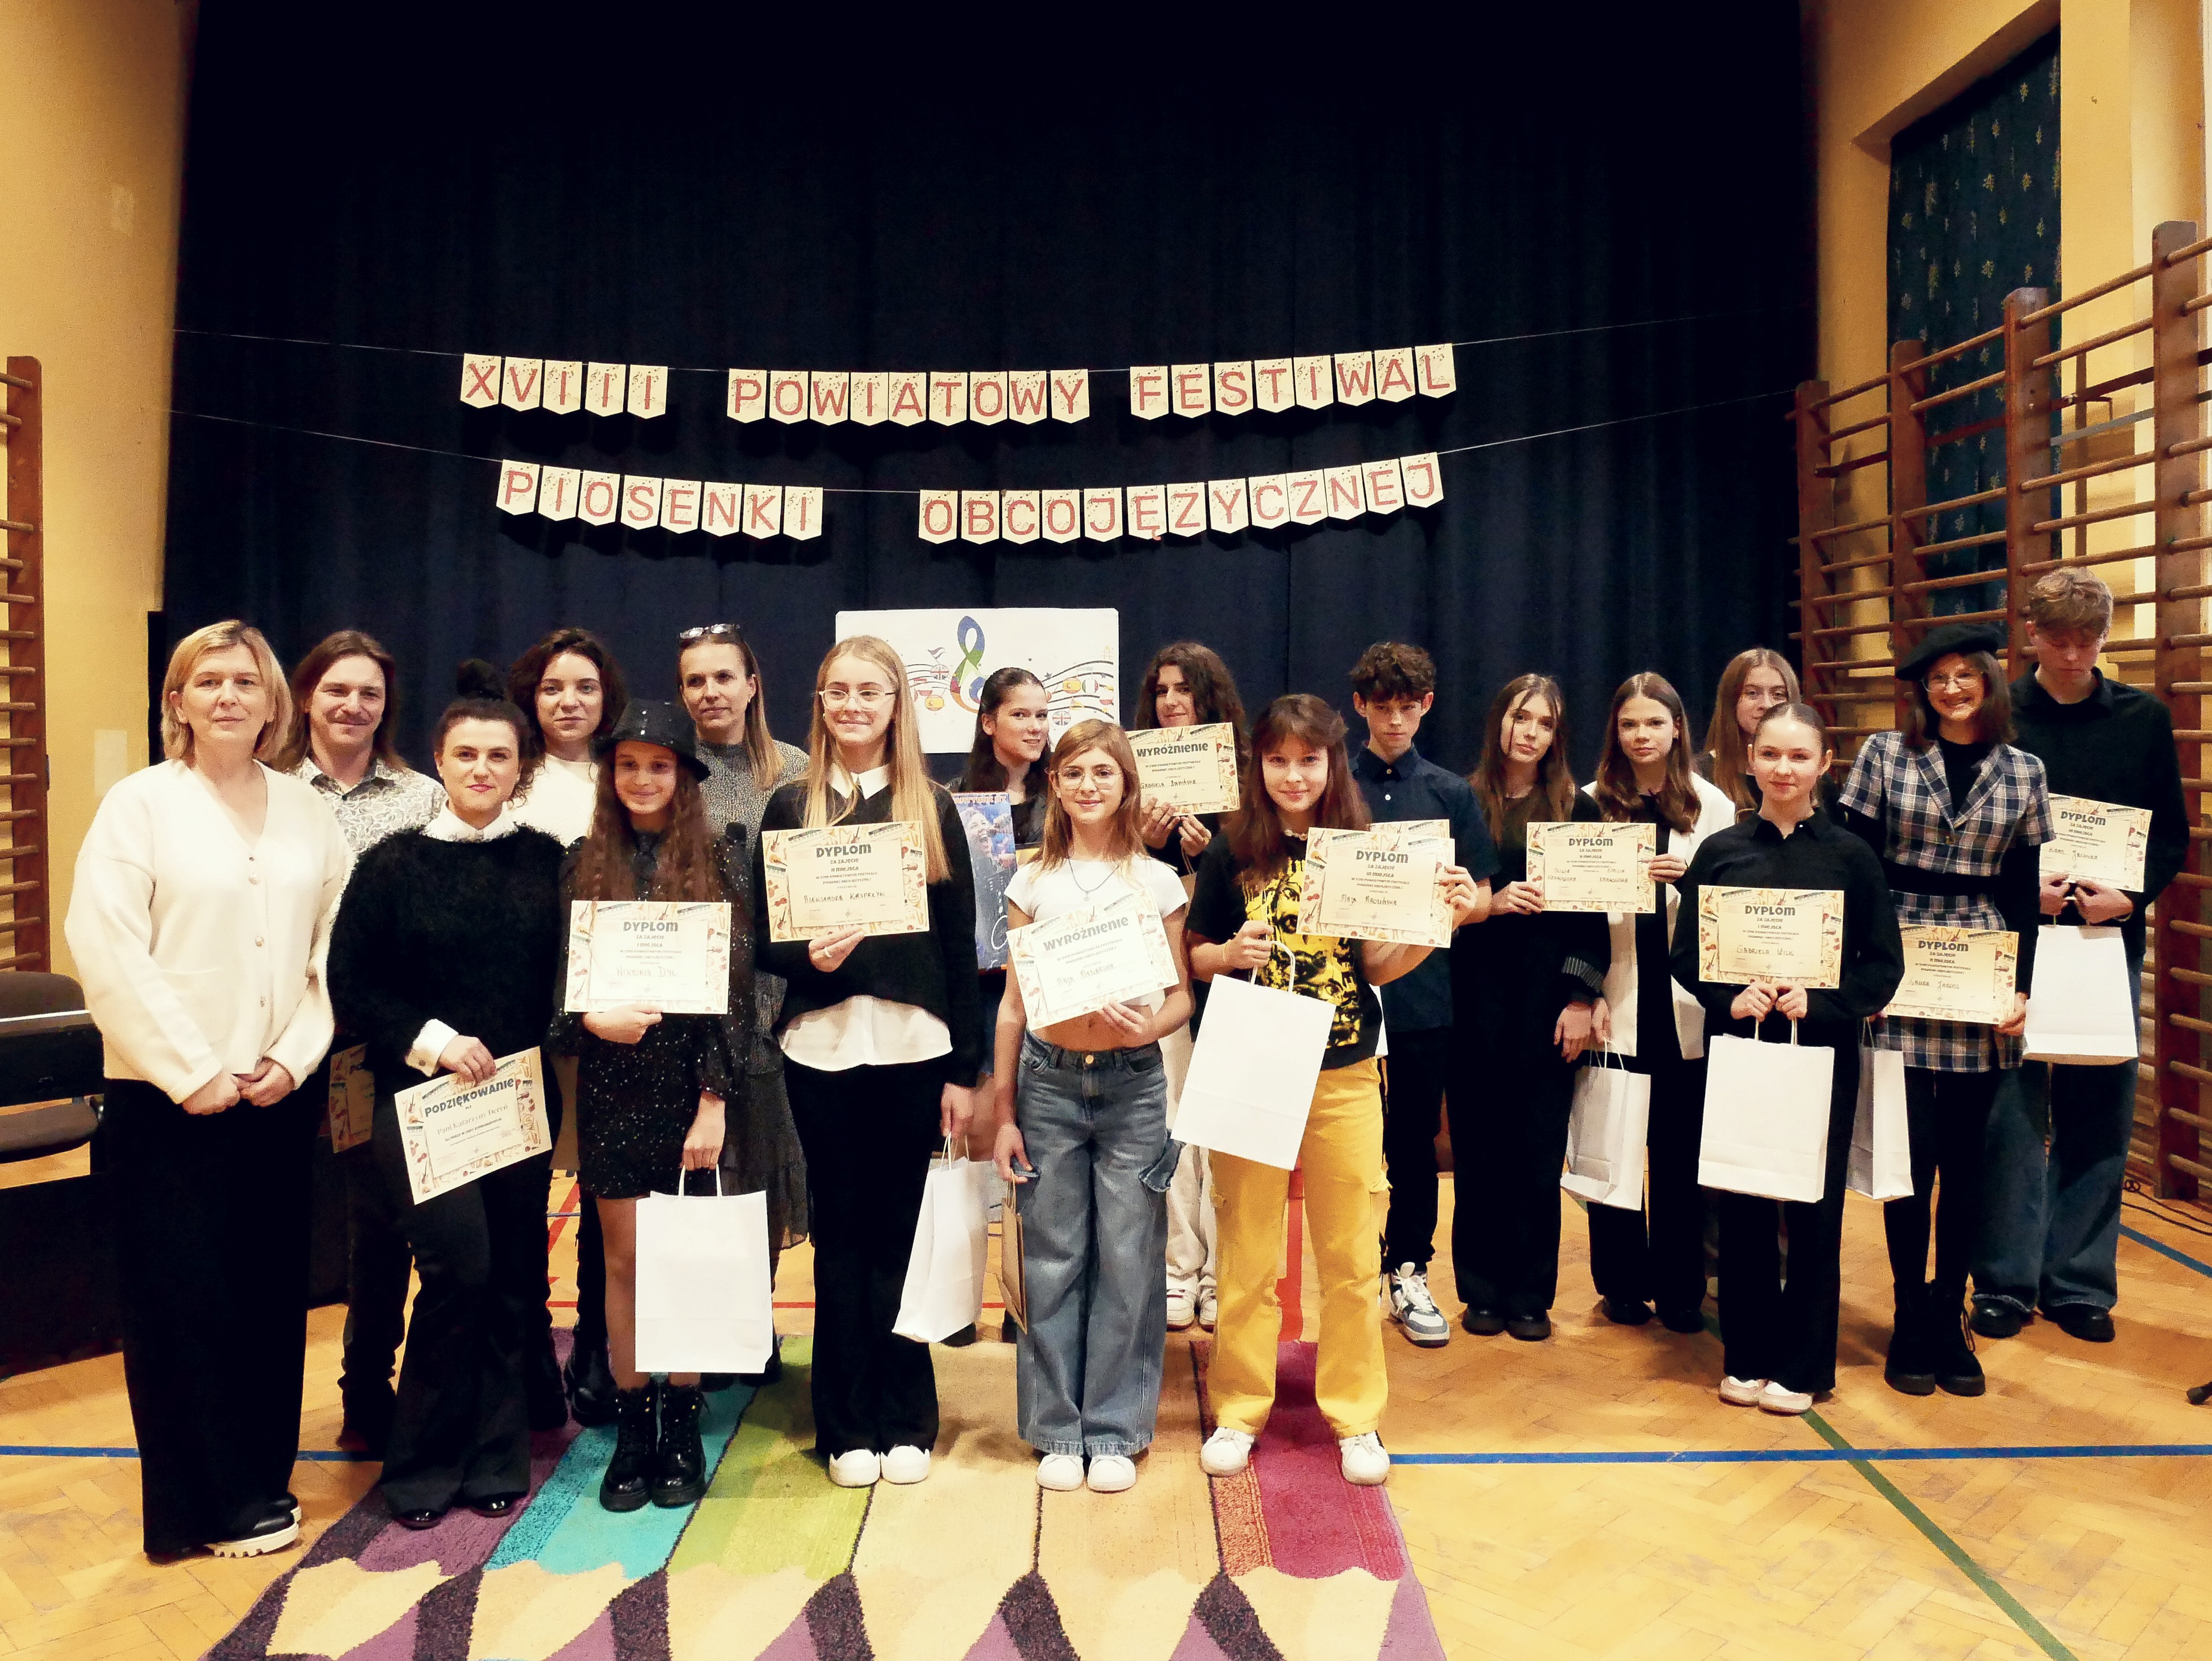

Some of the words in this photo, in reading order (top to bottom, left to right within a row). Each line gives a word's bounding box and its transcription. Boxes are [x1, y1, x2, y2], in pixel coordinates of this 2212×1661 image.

[465, 363, 652, 410] XVIII
[733, 378, 1085, 418] POWIATOWY
[1140, 355, 1452, 408] FESTIWAL
[504, 471, 807, 532] PIOSENKI
[924, 463, 1436, 541] OBCOJĘZYCZNEJ
[1136, 742, 1209, 757] WYRÓŻNIENIE
[2061, 811, 2106, 825] DYPLOM
[1569, 838, 1613, 846] DYPLOM
[816, 843, 872, 858] DYPLOM
[1356, 850, 1408, 863] DYPLOM
[1745, 905, 1795, 916] DYPLOM
[623, 921, 678, 932] DYPLOM
[1043, 916, 1129, 951] WYRÓŻNIENIE
[1918, 940, 1969, 952] DYPLOM
[425, 1078, 514, 1117] PODZIĘKOWANIE
